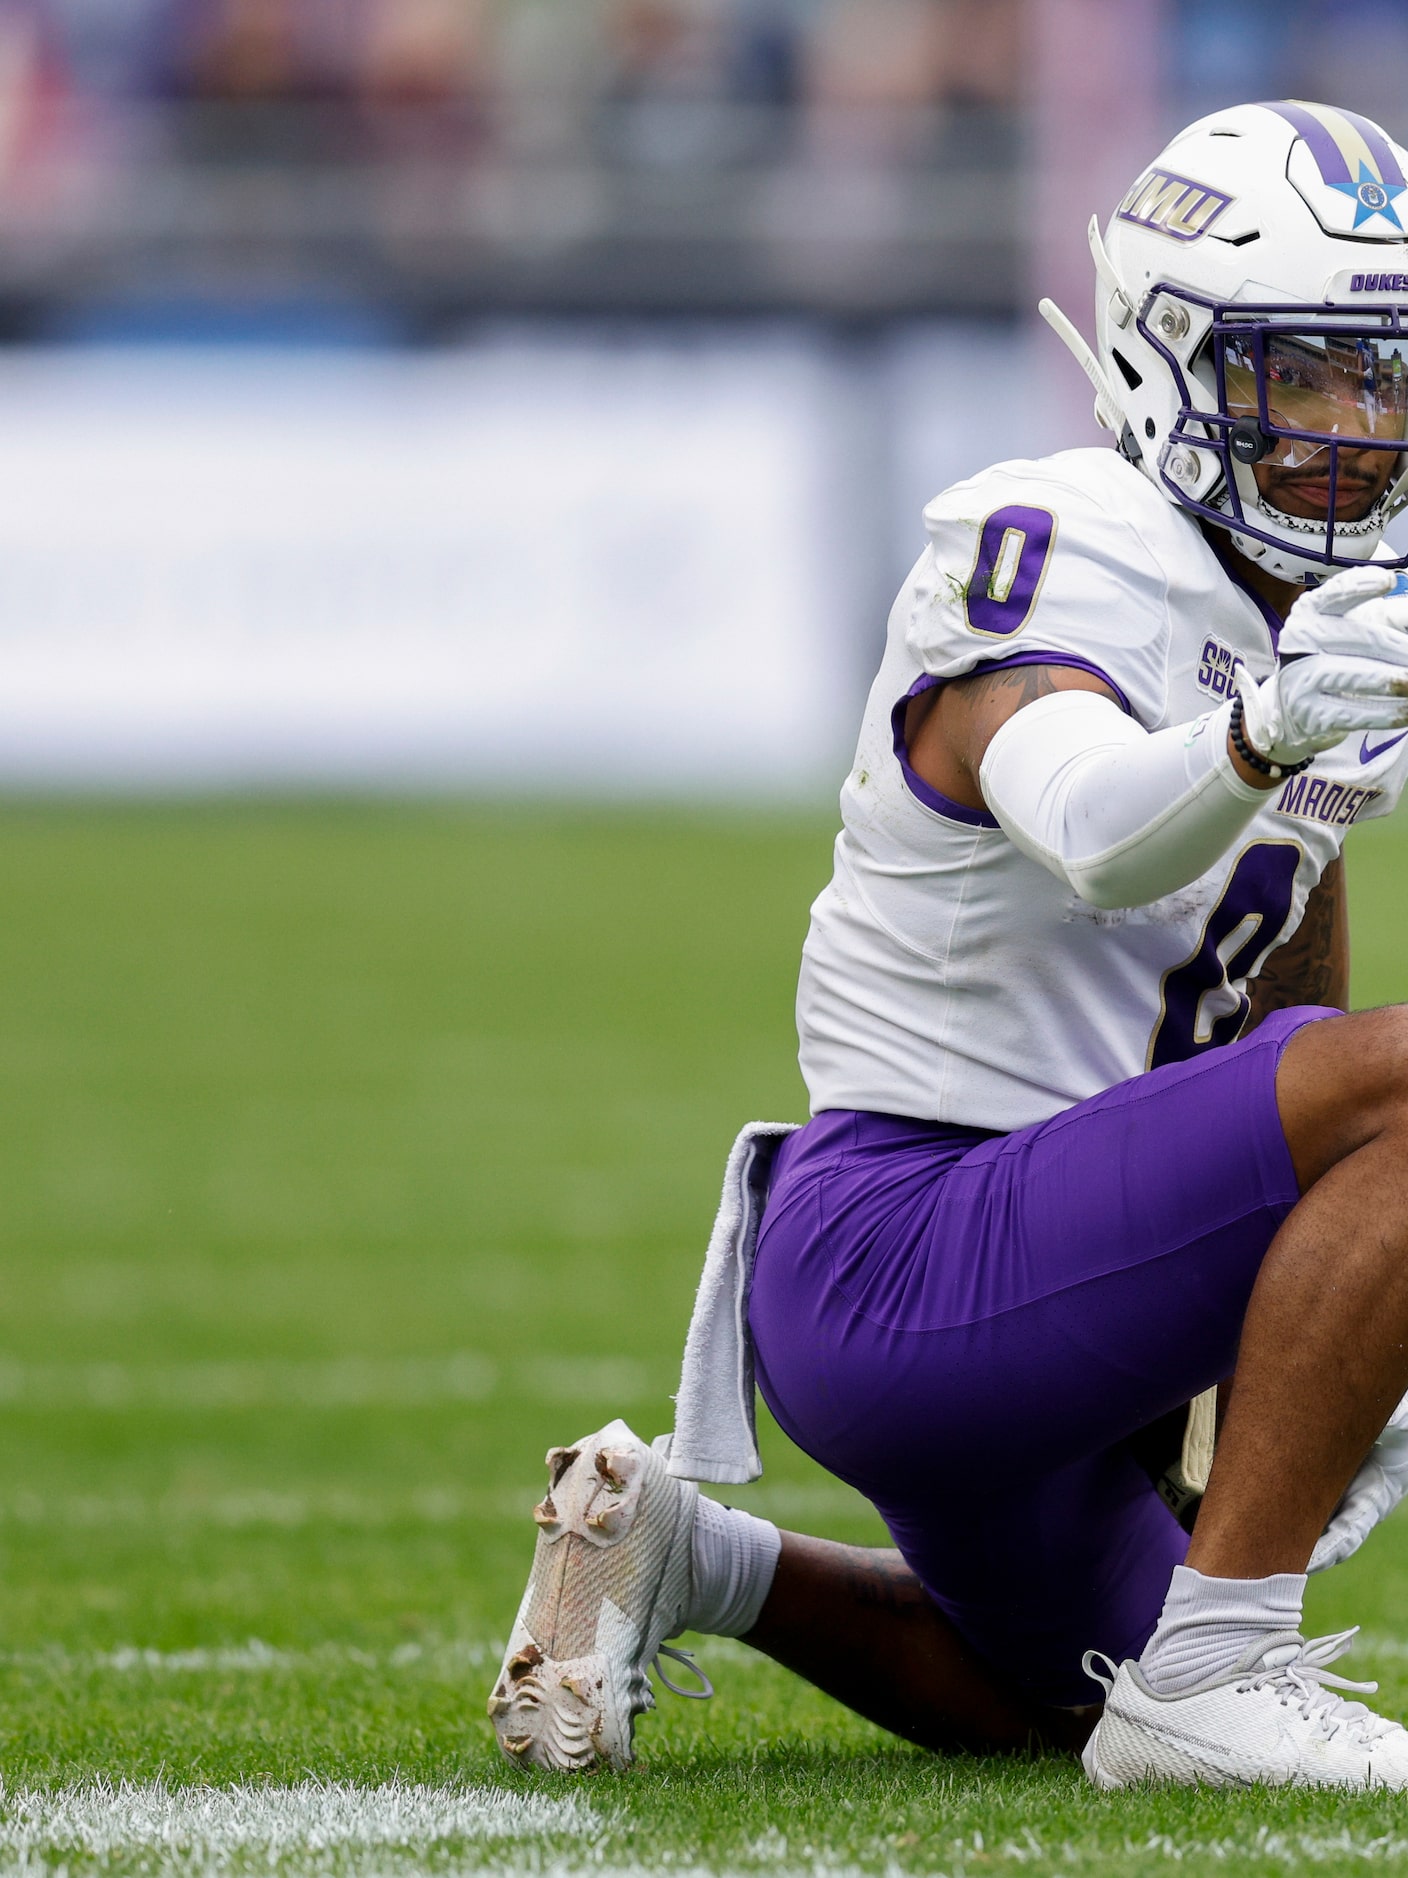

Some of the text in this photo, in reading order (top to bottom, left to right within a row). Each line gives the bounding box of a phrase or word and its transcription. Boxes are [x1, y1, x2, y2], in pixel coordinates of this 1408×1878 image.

[1119, 172, 1225, 236] JMU
[962, 502, 1059, 640] 0
[1275, 772, 1384, 826] MADISO
